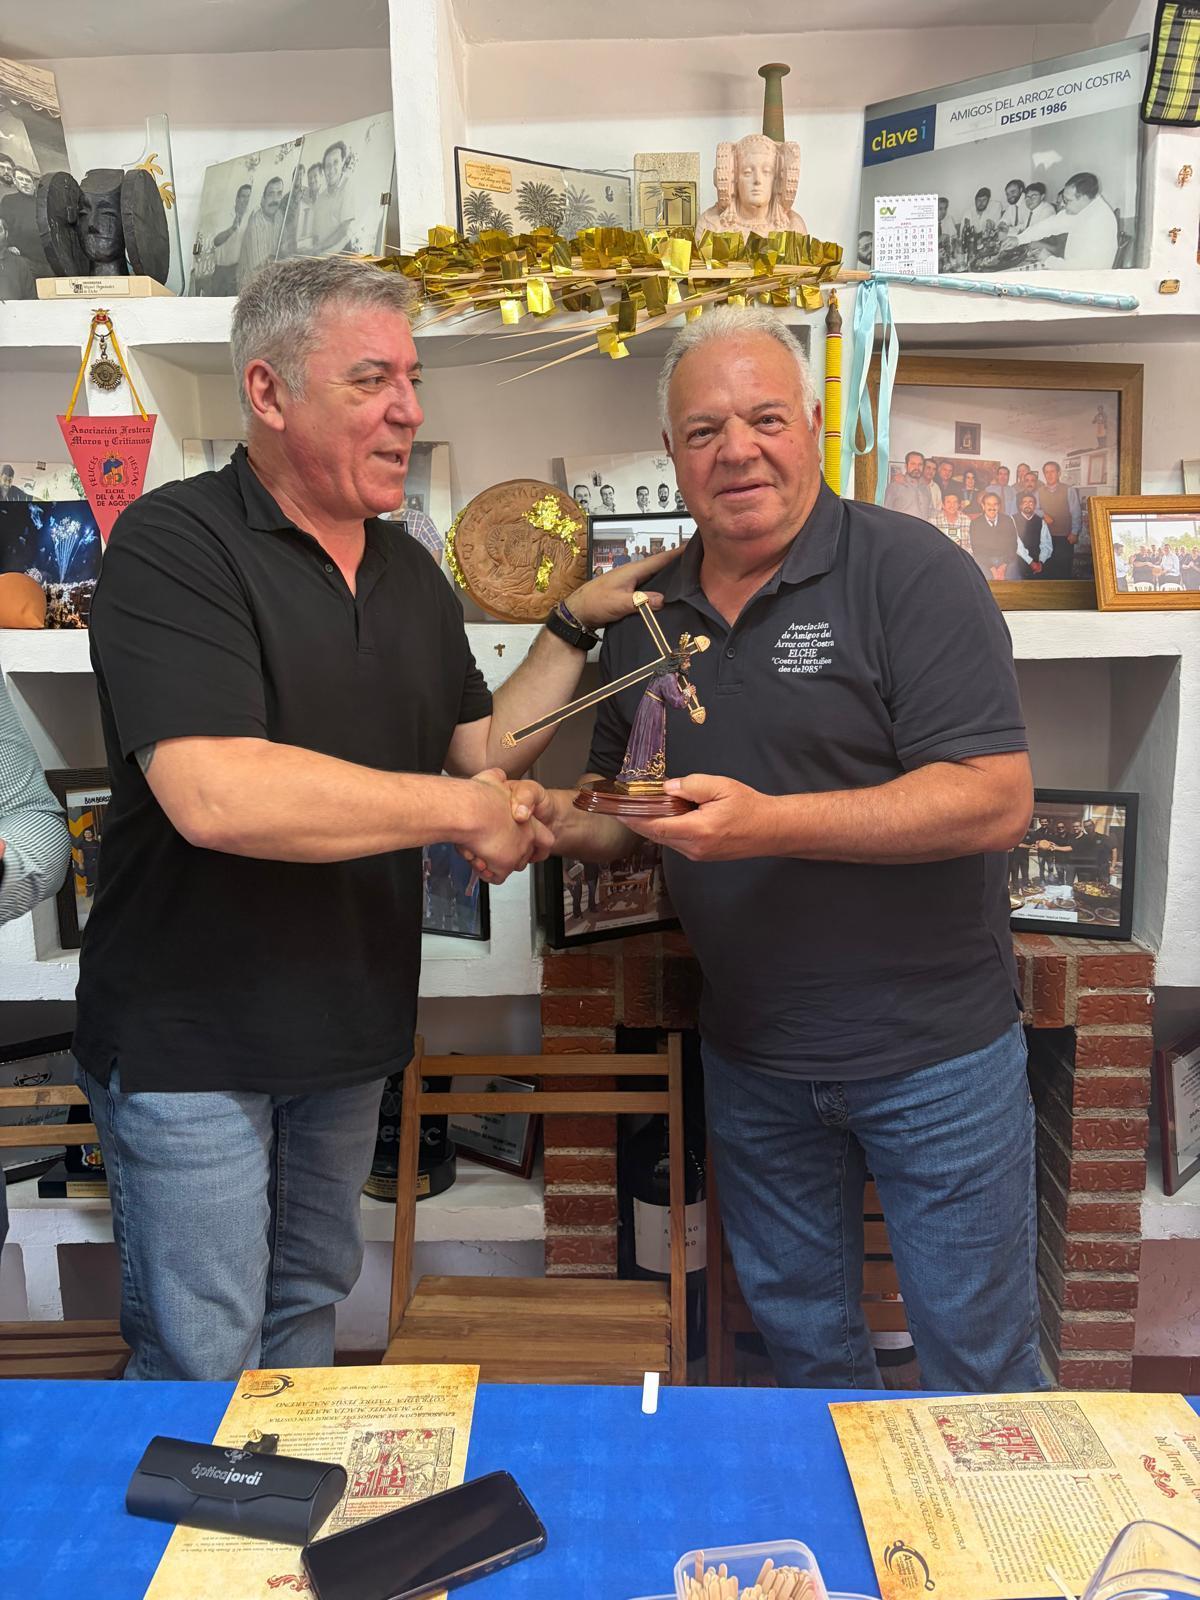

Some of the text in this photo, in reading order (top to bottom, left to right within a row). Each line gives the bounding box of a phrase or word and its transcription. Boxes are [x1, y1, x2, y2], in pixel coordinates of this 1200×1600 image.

[950, 69, 1131, 123] AMIGOS DEL ARROZ CON COSTRA
[1000, 102, 1067, 126] DESDE 1986
[69, 425, 117, 435] Asociación
[70, 436, 101, 445] Moros
[89, 456, 98, 487] FELICES
[128, 456, 138, 486] FIESTAS
[788, 622, 829, 630] Asociación
[781, 631, 791, 639] de
[821, 630, 832, 638] del
[774, 639, 796, 648] Arroz
[788, 649, 818, 658] ELCHE
